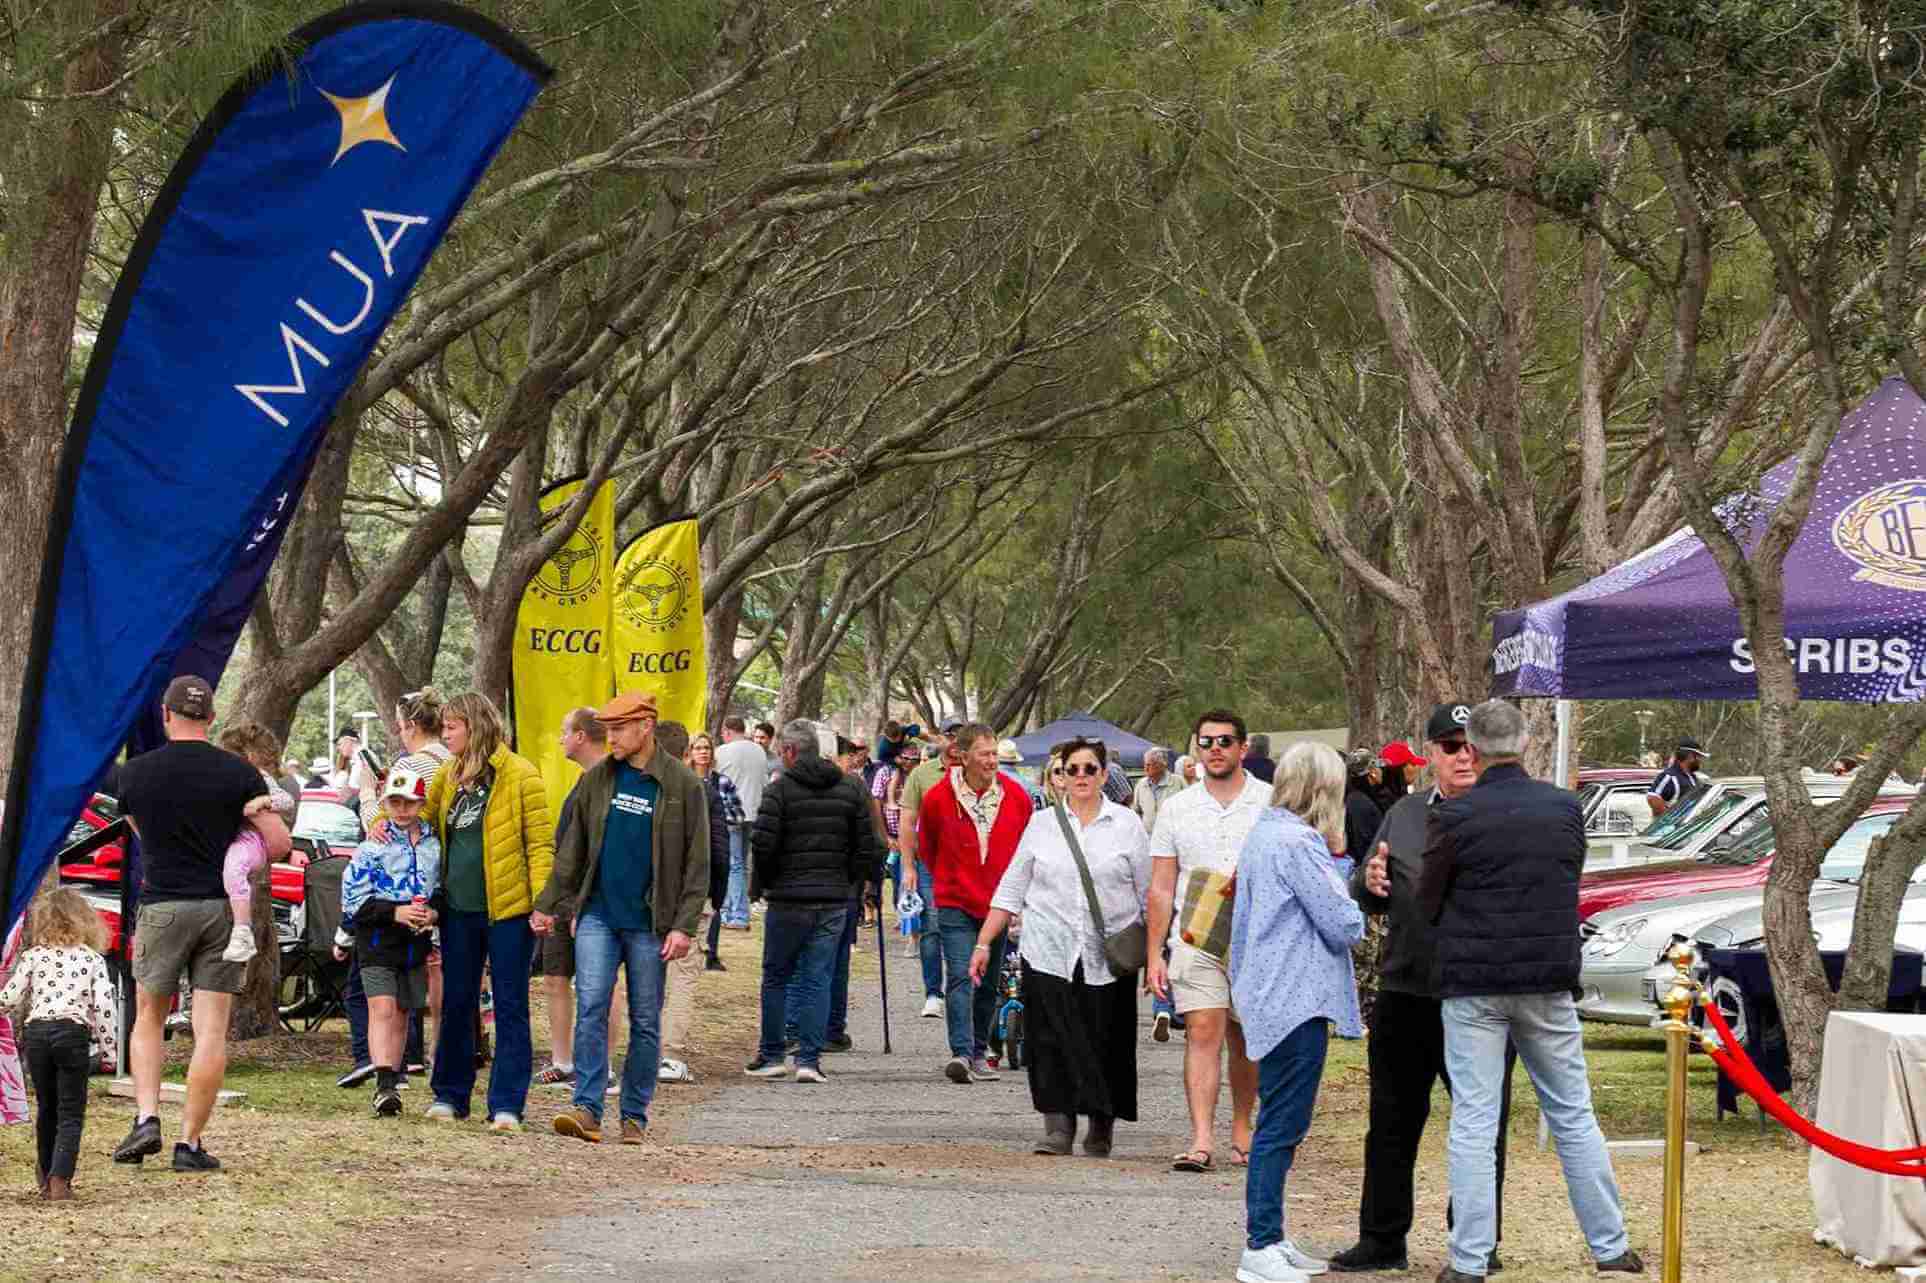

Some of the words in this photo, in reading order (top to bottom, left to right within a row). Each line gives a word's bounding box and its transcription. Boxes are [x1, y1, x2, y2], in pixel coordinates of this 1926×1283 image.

[234, 209, 429, 427] MUA
[529, 627, 601, 654] ECCG
[1729, 637, 1913, 674] SRIBS
[629, 649, 691, 673] ECCG
